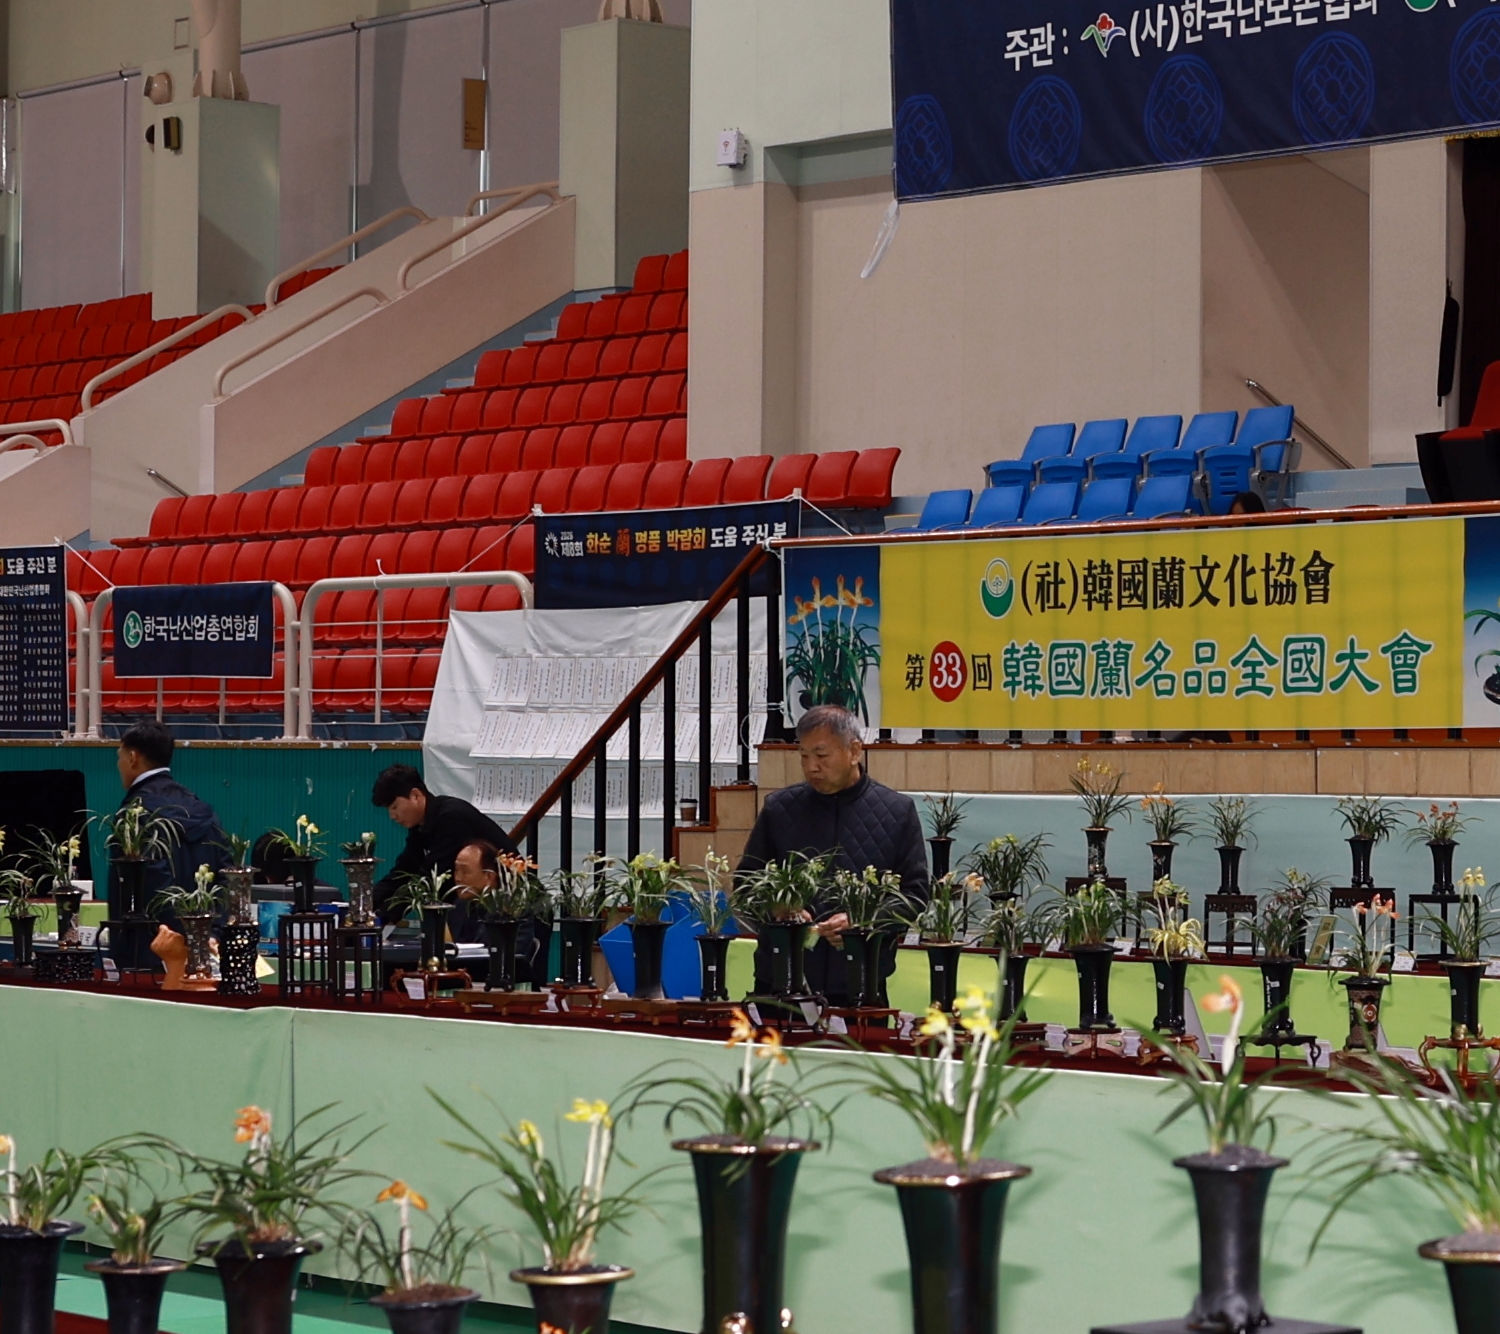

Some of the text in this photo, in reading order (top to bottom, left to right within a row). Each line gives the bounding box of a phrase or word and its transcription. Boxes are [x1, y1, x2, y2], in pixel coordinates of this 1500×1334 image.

[1004, 23, 1055, 71] 주관
[586, 532, 612, 554] 화순
[634, 530, 661, 553] 명품
[666, 527, 706, 551] 박람회
[710, 526, 737, 548] 도움
[741, 523, 769, 545] 주신
[7, 558, 24, 575] 도움
[27, 557, 45, 574] 주신
[47, 556, 57, 574] 분
[1020, 550, 1336, 616] (社)韓國蘭文化協會
[143, 614, 259, 642] 한국난산업총연합회
[1001, 629, 1434, 701] 韓國蘭名品全國大會
